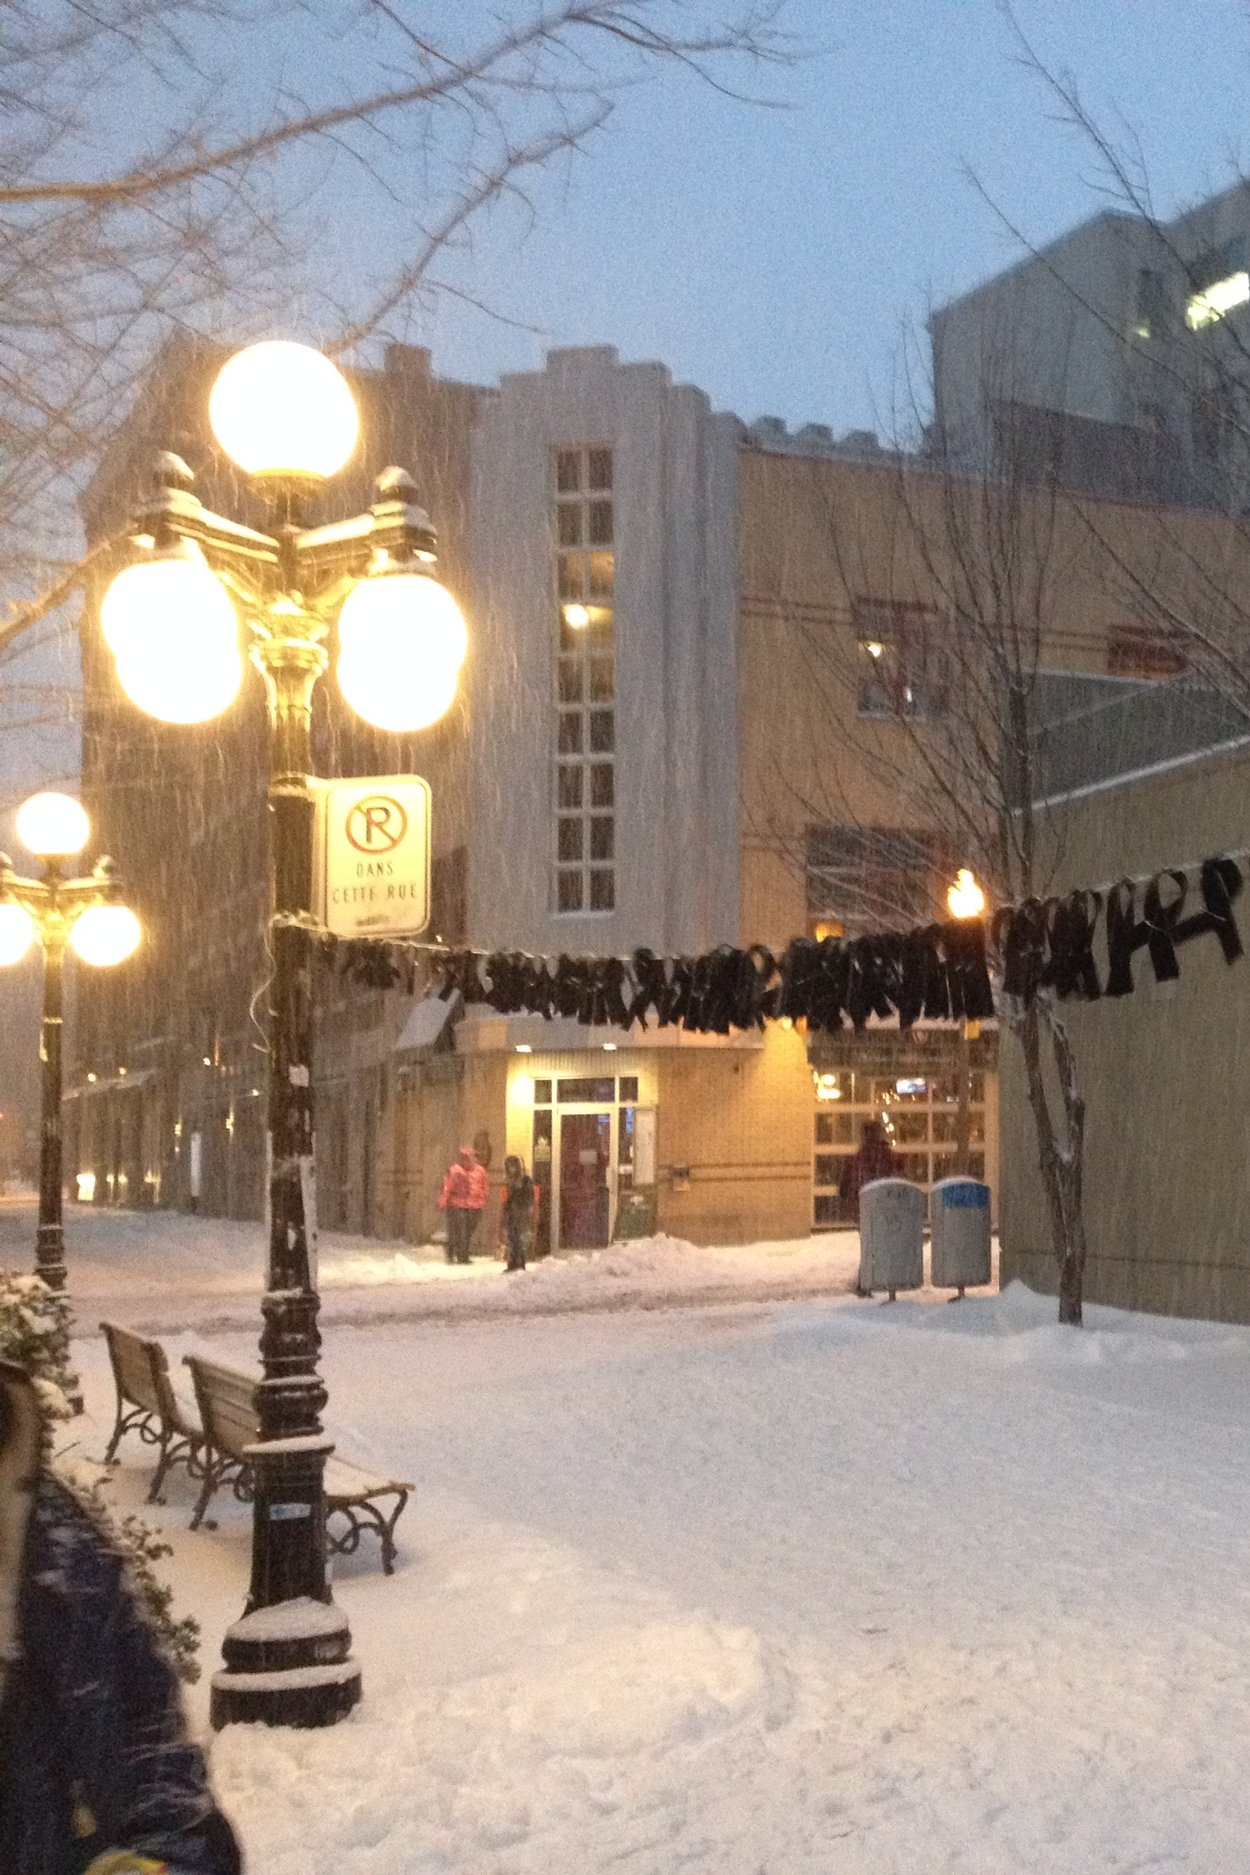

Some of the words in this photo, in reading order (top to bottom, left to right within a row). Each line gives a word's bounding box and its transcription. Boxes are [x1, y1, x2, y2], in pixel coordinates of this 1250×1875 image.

[356, 860, 394, 877] DANS
[332, 886, 376, 904] CETTE
[387, 883, 418, 900] RUE
